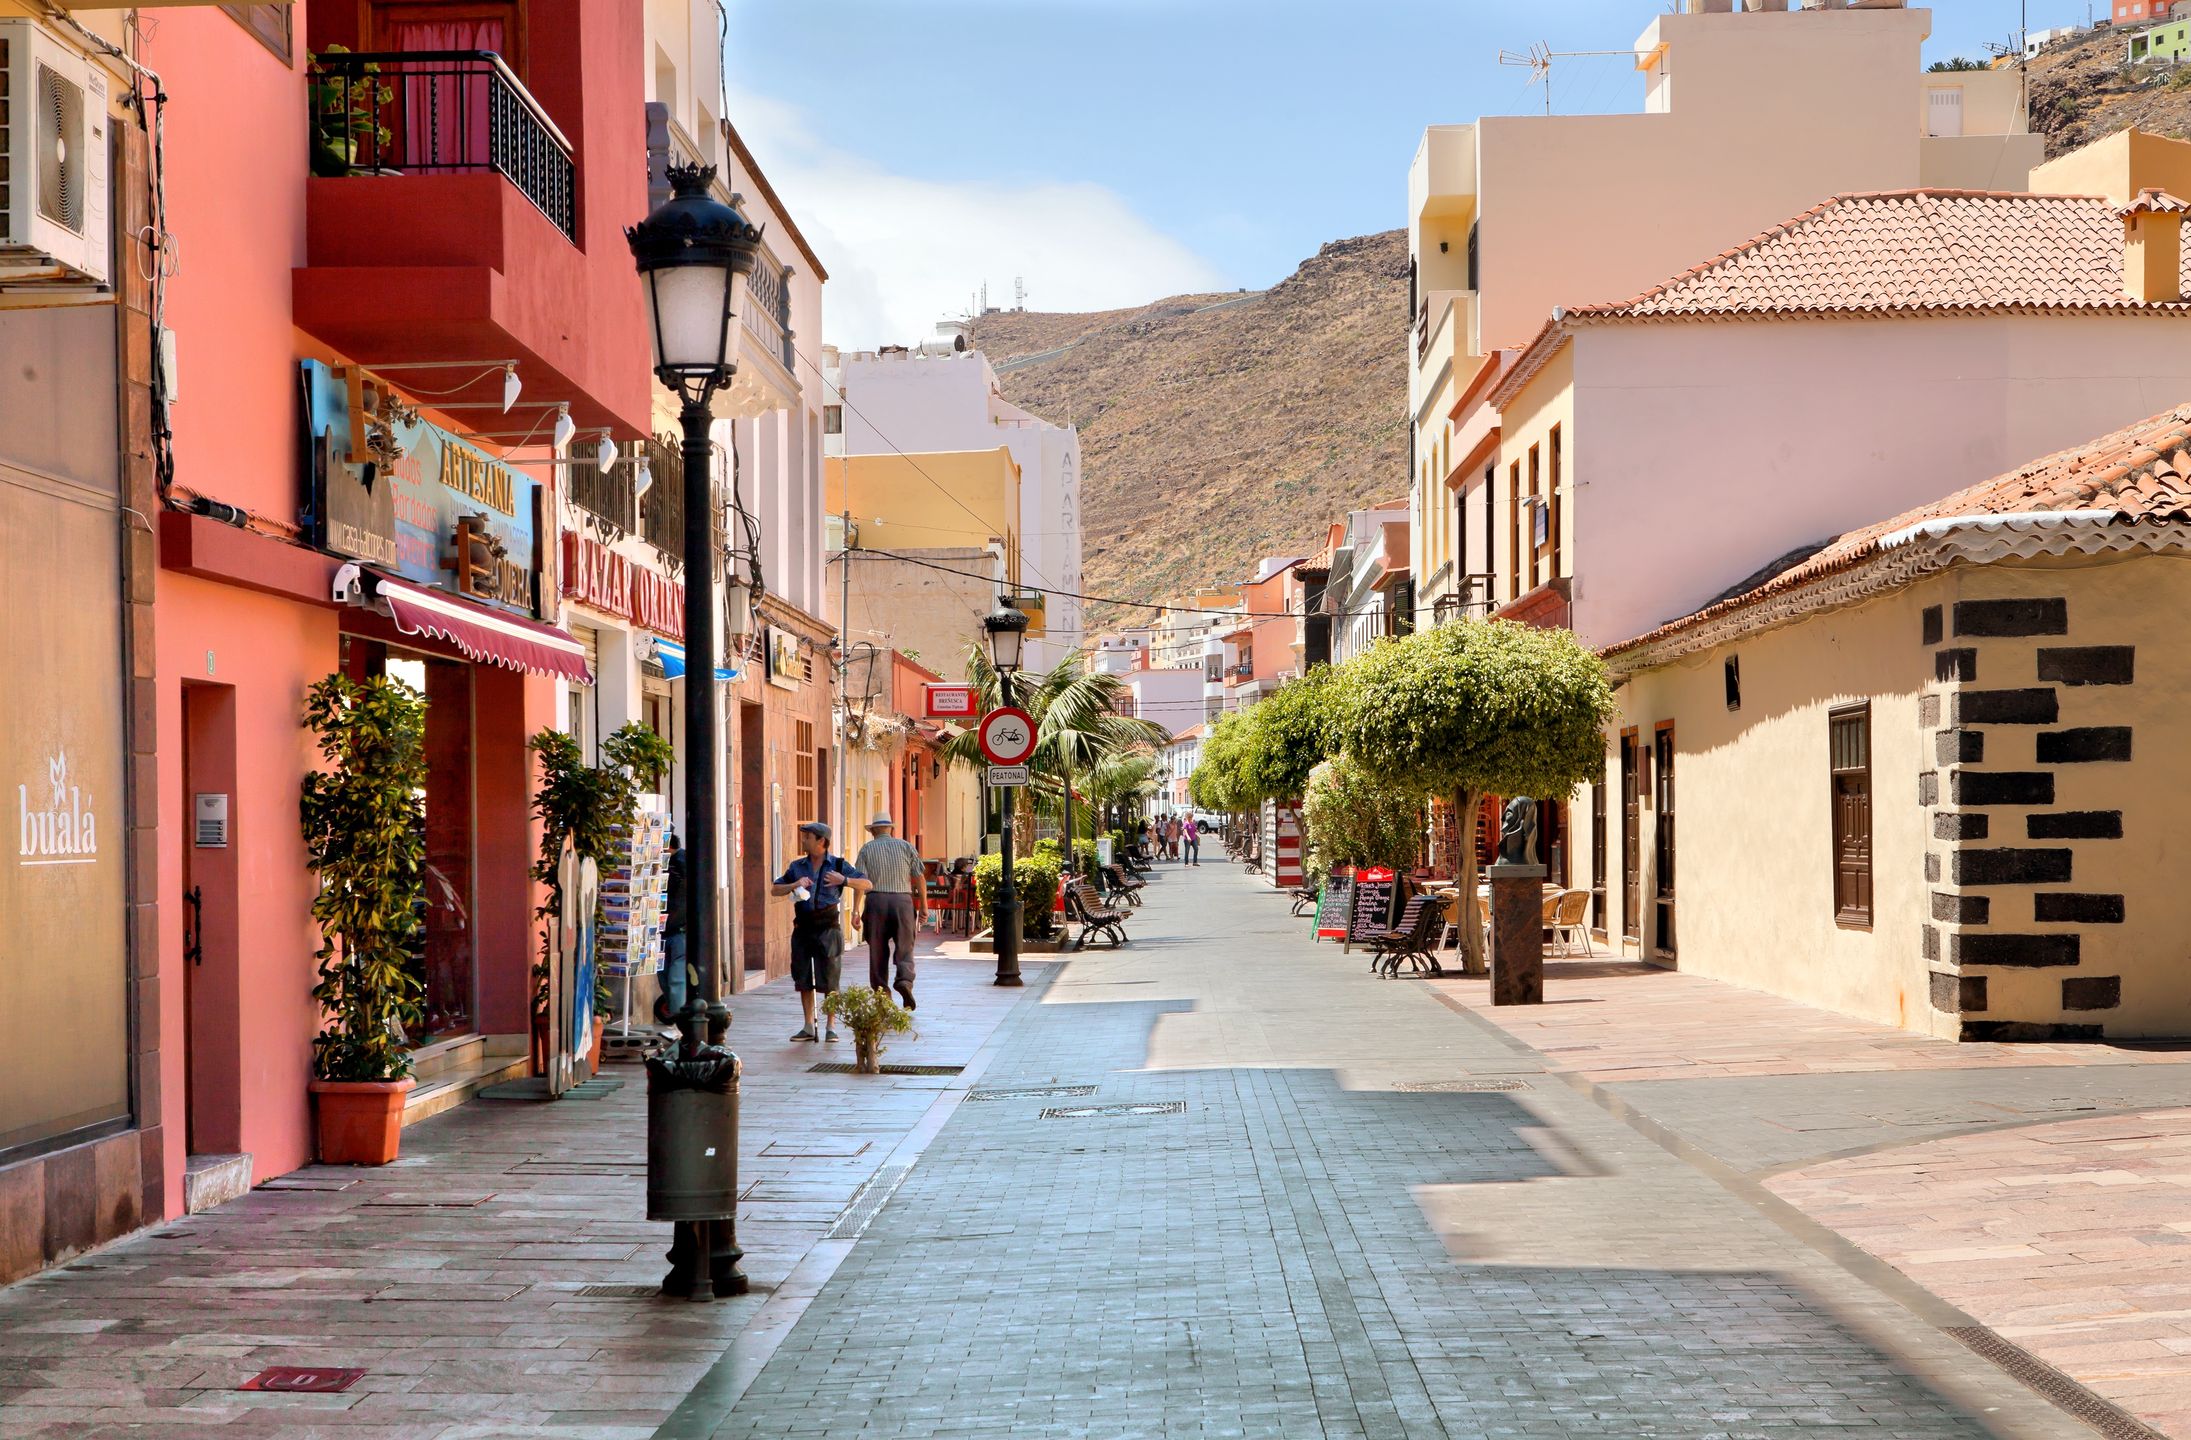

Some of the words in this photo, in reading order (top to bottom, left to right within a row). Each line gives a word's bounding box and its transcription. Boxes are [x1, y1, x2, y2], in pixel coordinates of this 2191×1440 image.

[577, 532, 634, 619] BAZAR
[640, 565, 685, 641] ORIEN
[992, 771, 1025, 780] PEATONAL
[18, 783, 97, 856] bualá
